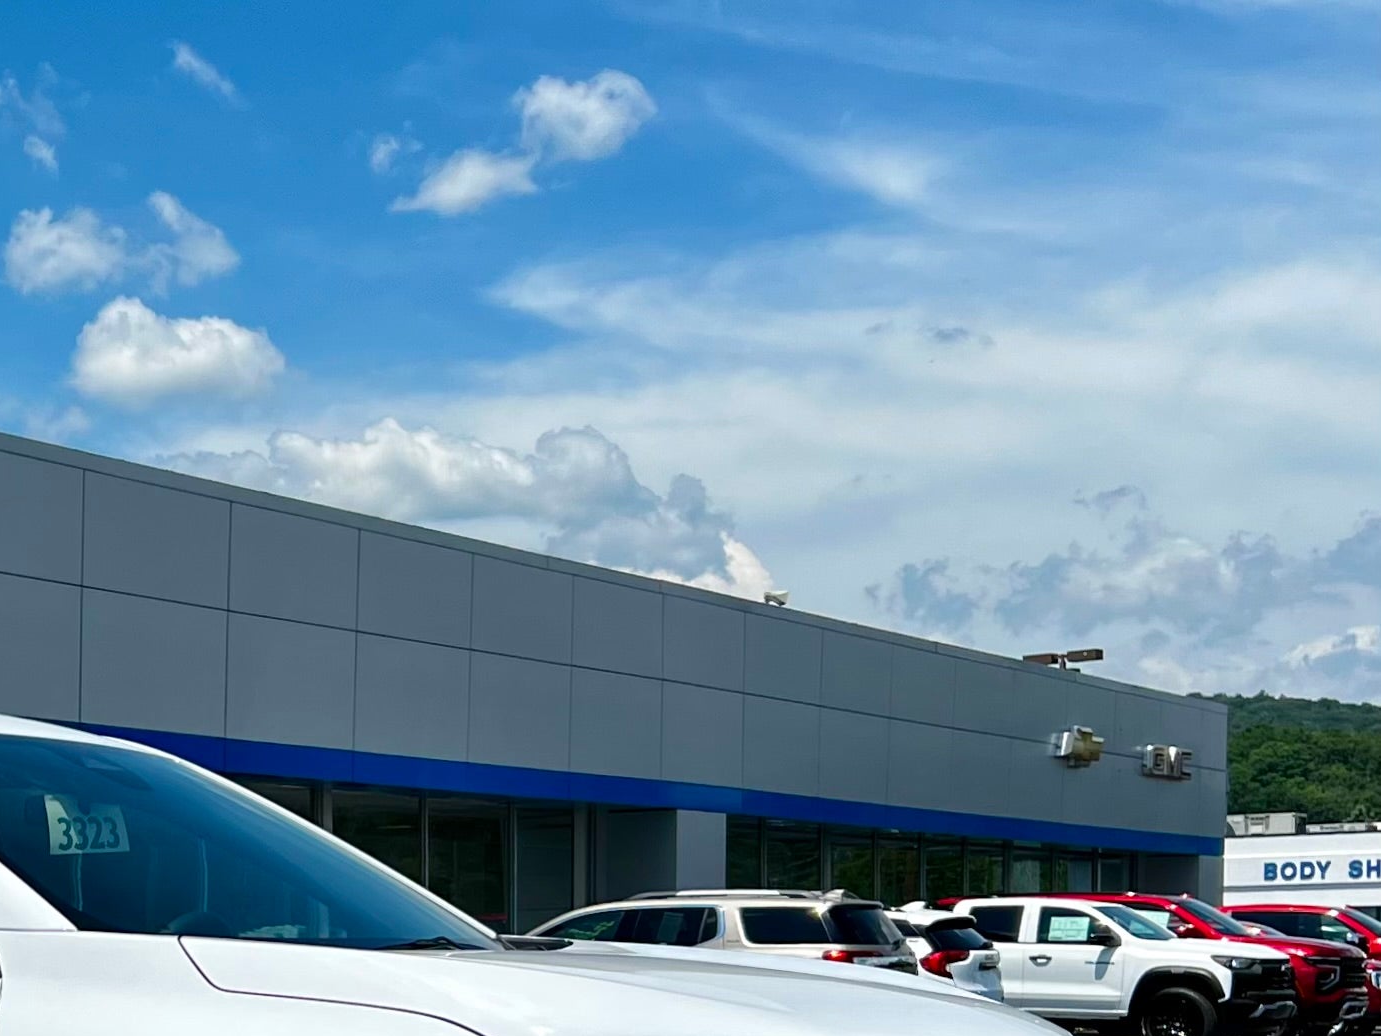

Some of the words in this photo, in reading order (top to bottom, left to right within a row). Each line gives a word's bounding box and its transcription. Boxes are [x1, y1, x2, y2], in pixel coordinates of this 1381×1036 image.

[57, 816, 120, 851] 3323
[1263, 860, 1331, 882] BODY
[1348, 858, 1381, 880] SH
